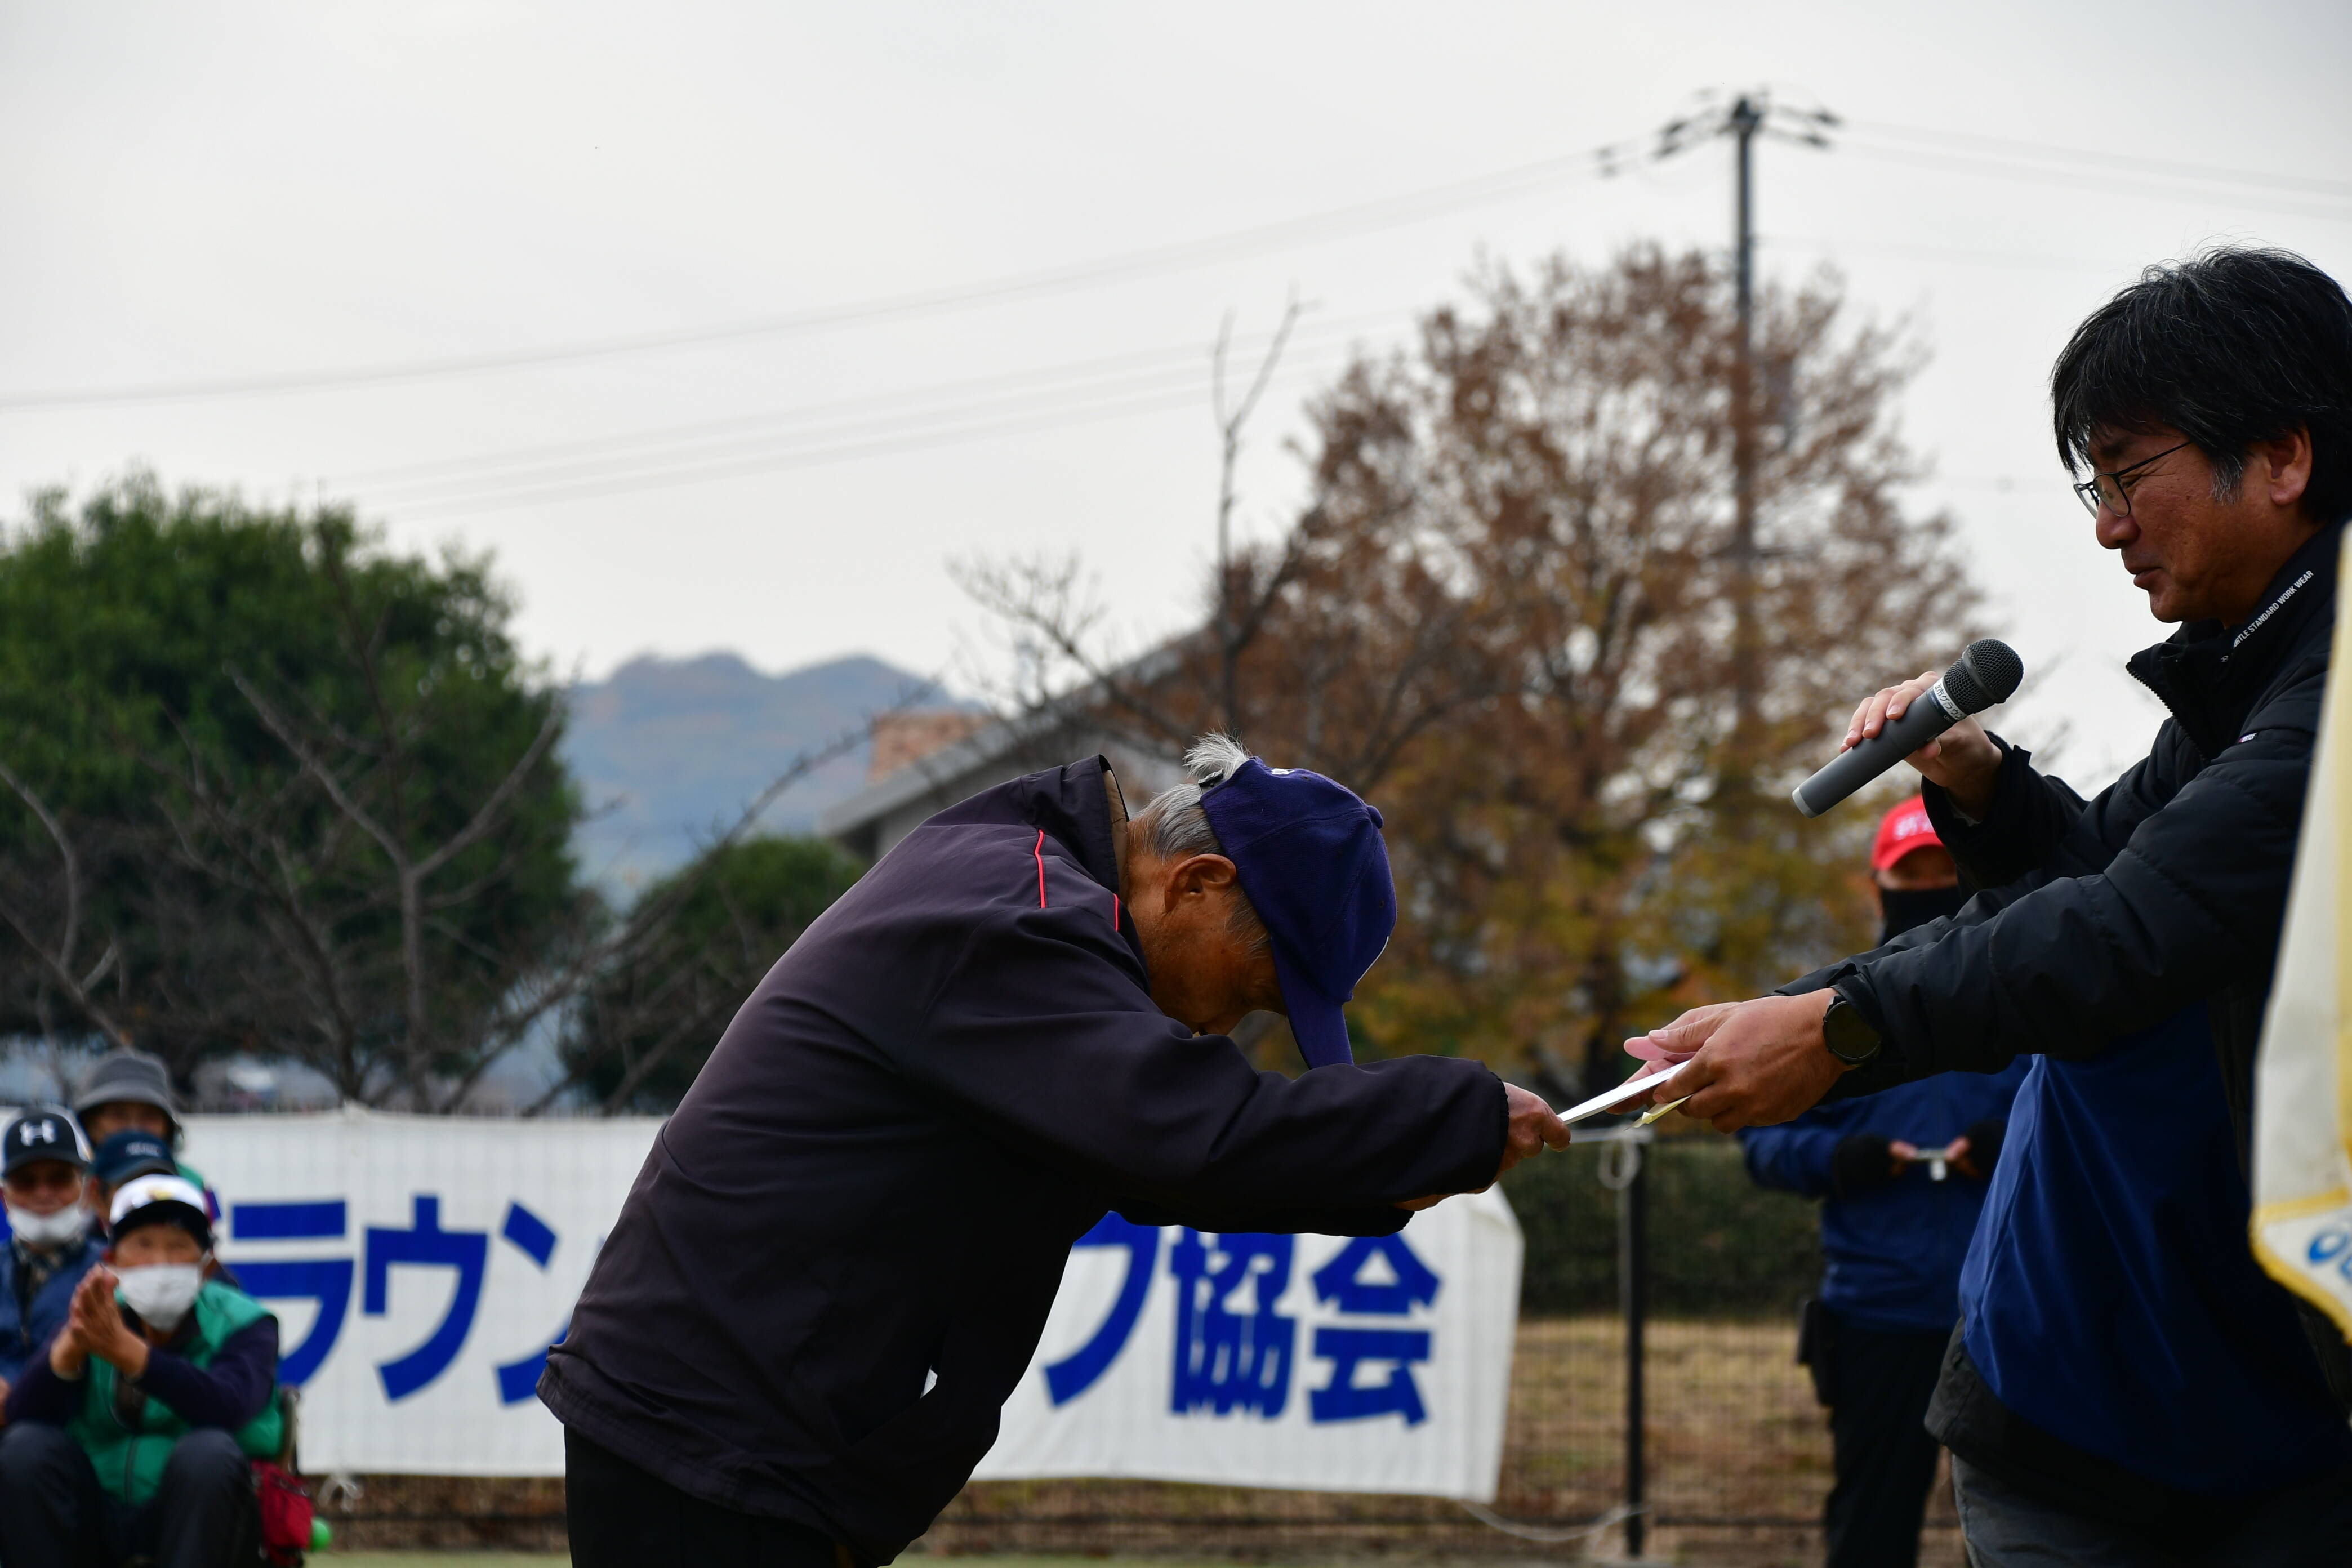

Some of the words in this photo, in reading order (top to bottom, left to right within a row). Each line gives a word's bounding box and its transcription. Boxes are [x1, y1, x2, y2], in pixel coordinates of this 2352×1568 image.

[2233, 630, 2250, 648] URTLE
[2248, 602, 2279, 632] STANDARD
[2277, 586, 2297, 604] WORK
[2294, 570, 2314, 588] WEAR
